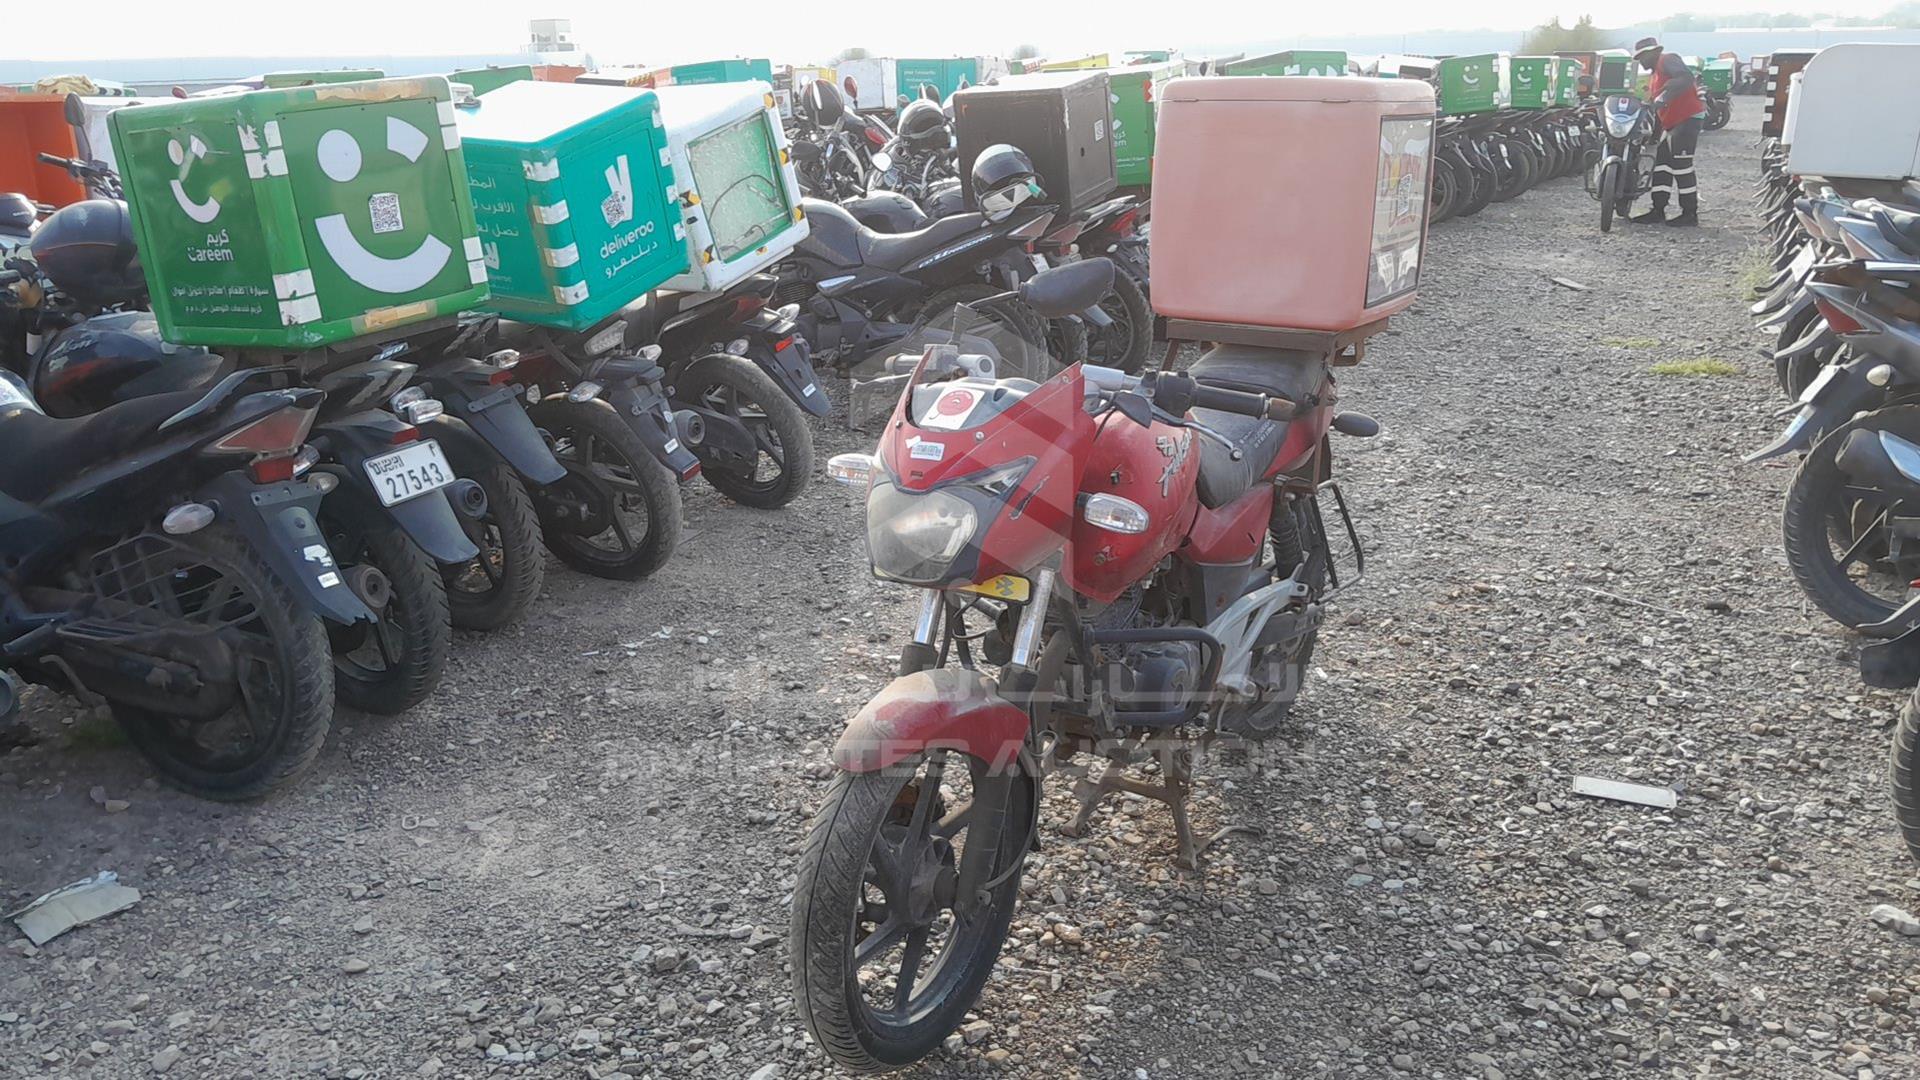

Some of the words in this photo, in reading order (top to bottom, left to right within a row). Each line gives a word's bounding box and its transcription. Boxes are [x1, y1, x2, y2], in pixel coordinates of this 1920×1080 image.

[468, 175, 497, 190] المط
[207, 228, 230, 247] كريم
[600, 220, 655, 259] deliveroo
[187, 247, 234, 262] Careem
[386, 462, 445, 499] 27543
